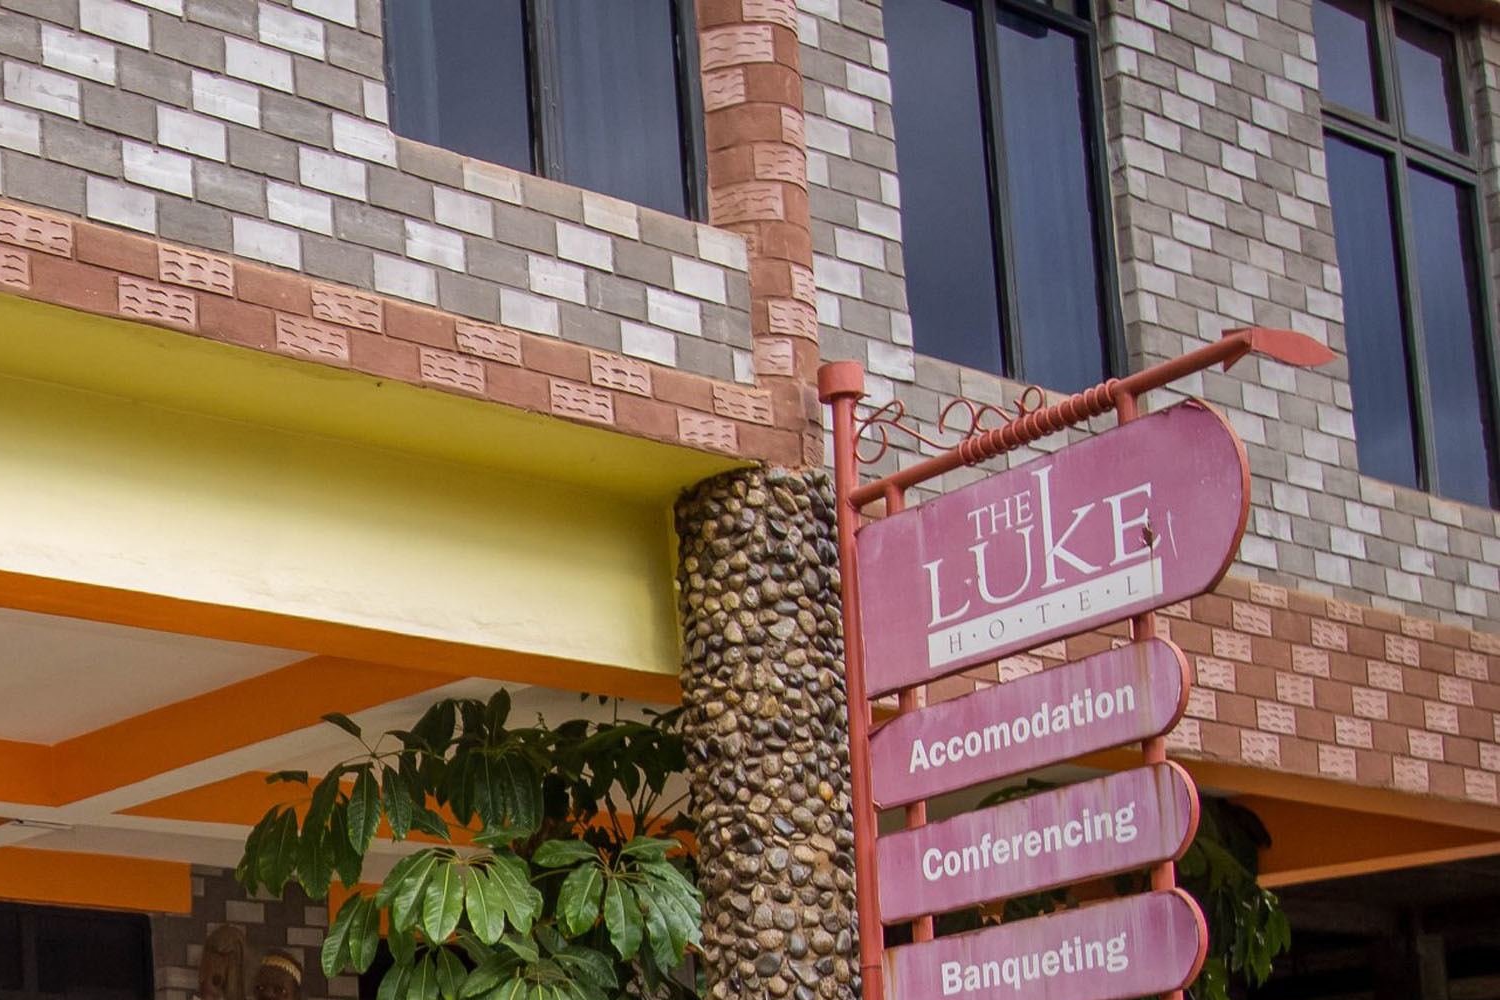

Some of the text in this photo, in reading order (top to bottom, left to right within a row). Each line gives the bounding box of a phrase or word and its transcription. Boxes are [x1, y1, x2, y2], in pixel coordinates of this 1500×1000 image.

[967, 490, 1035, 541] THE
[908, 683, 1135, 774] Accomodation
[922, 801, 1138, 881] Conferencing
[941, 932, 1129, 995] Banqueting
